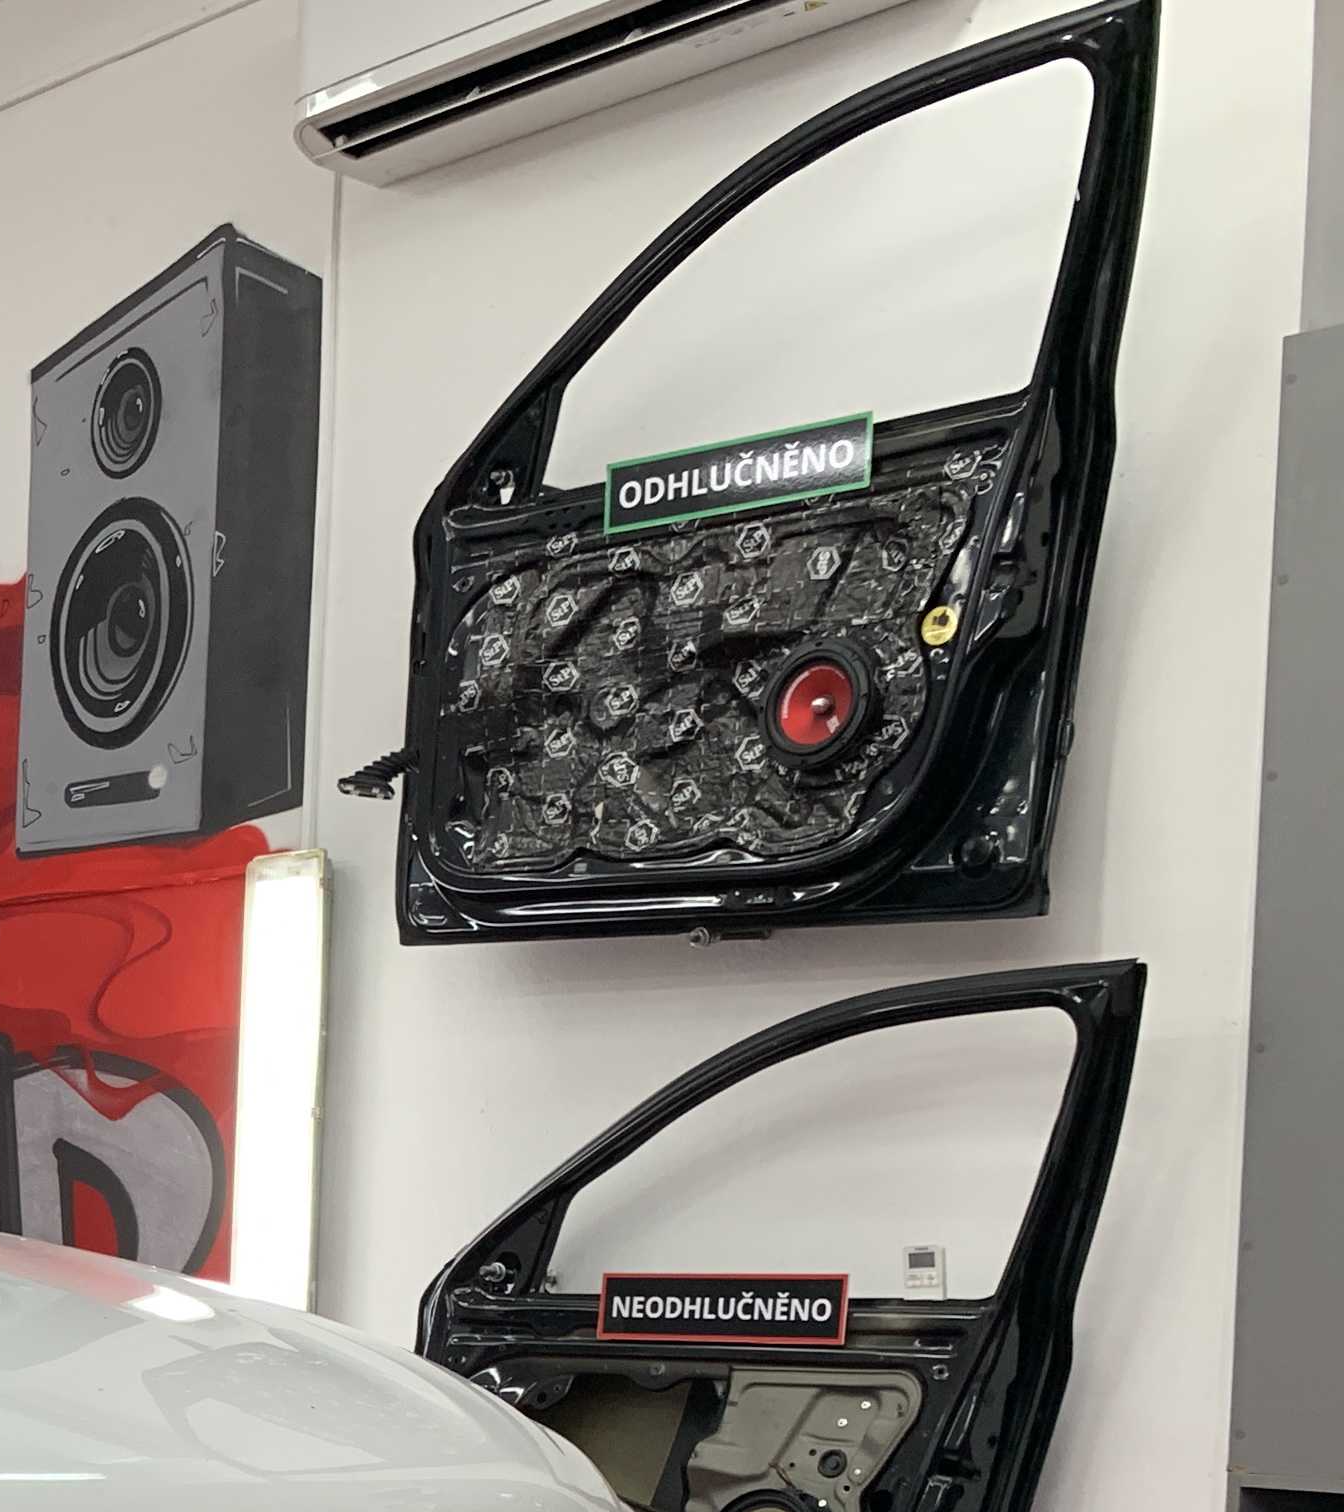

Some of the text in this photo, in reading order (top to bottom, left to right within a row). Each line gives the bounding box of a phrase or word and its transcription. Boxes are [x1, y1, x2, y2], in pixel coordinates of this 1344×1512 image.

[618, 440, 855, 510] ODHLUČNĚNO
[494, 579, 514, 599] StP
[550, 603, 572, 621] StP
[549, 667, 571, 687] StP
[611, 1291, 833, 1322] NEODHLUČNĚNO
